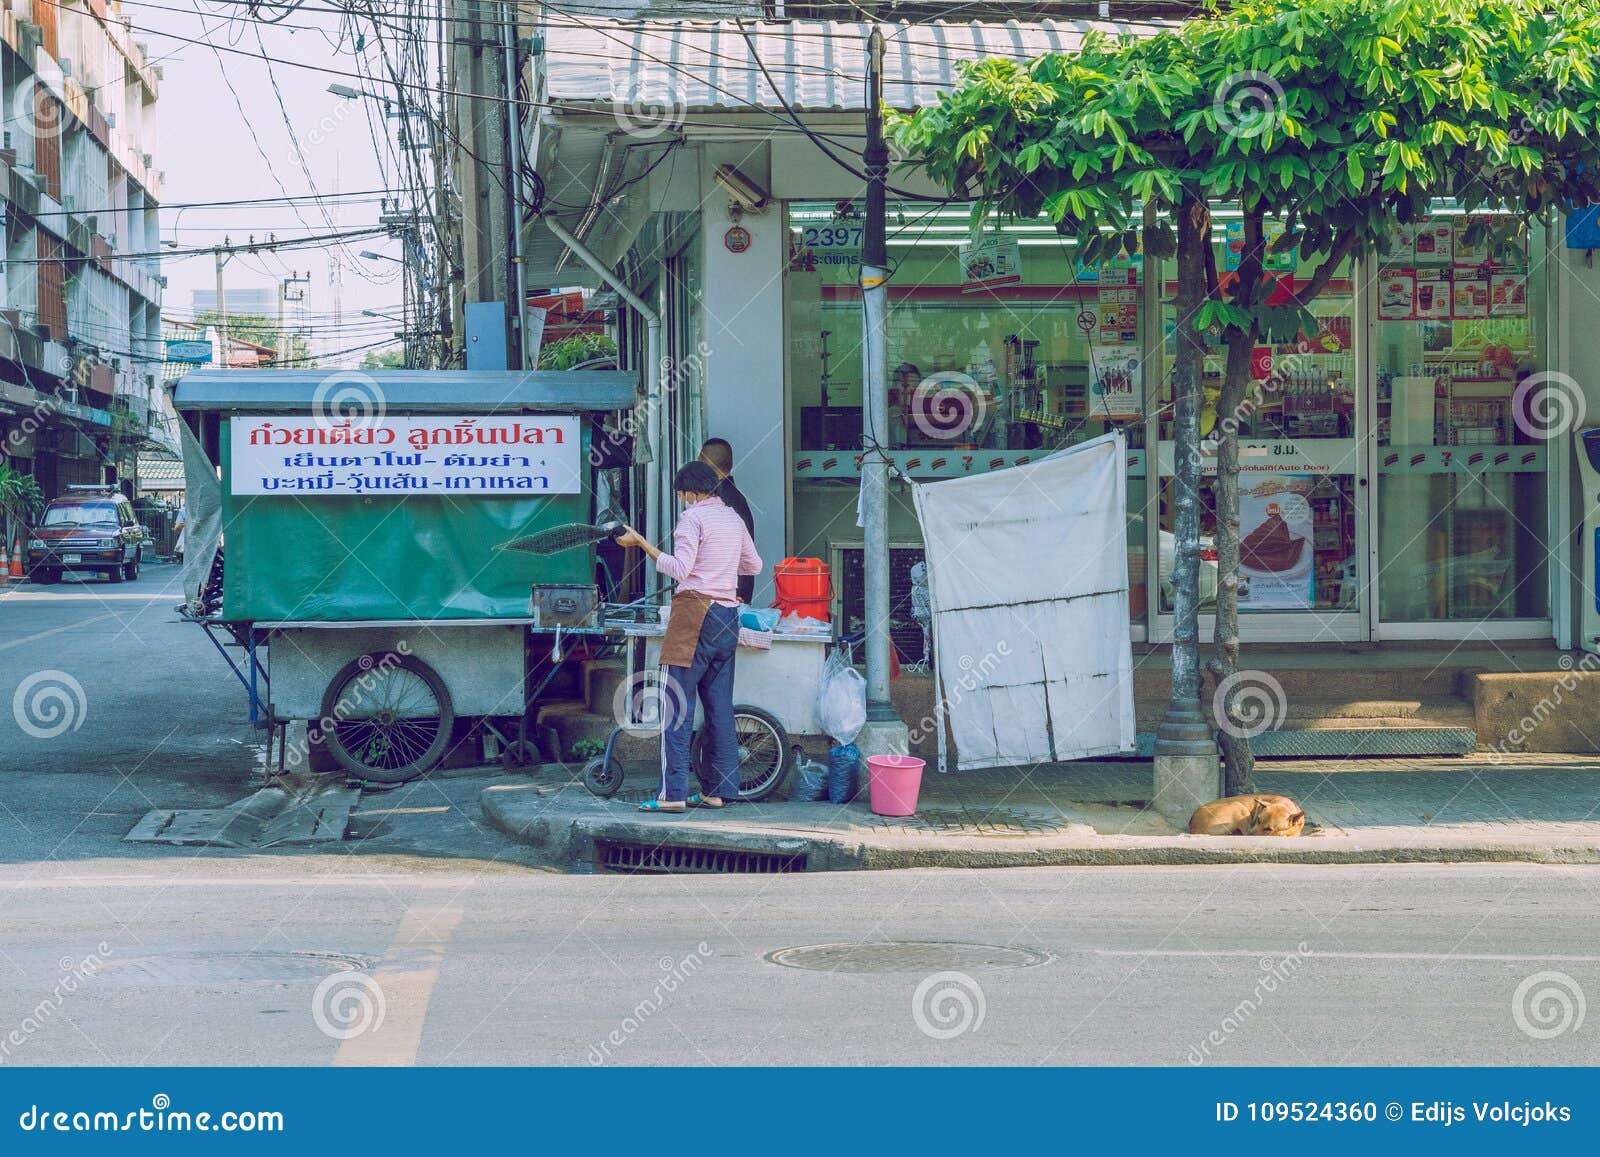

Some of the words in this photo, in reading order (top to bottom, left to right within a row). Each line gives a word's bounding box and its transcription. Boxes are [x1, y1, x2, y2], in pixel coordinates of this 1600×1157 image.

[805, 228, 863, 247] 2397
[408, 419, 567, 451] ลูกชิ้นปลา
[444, 453, 531, 467] ต้มยำ
